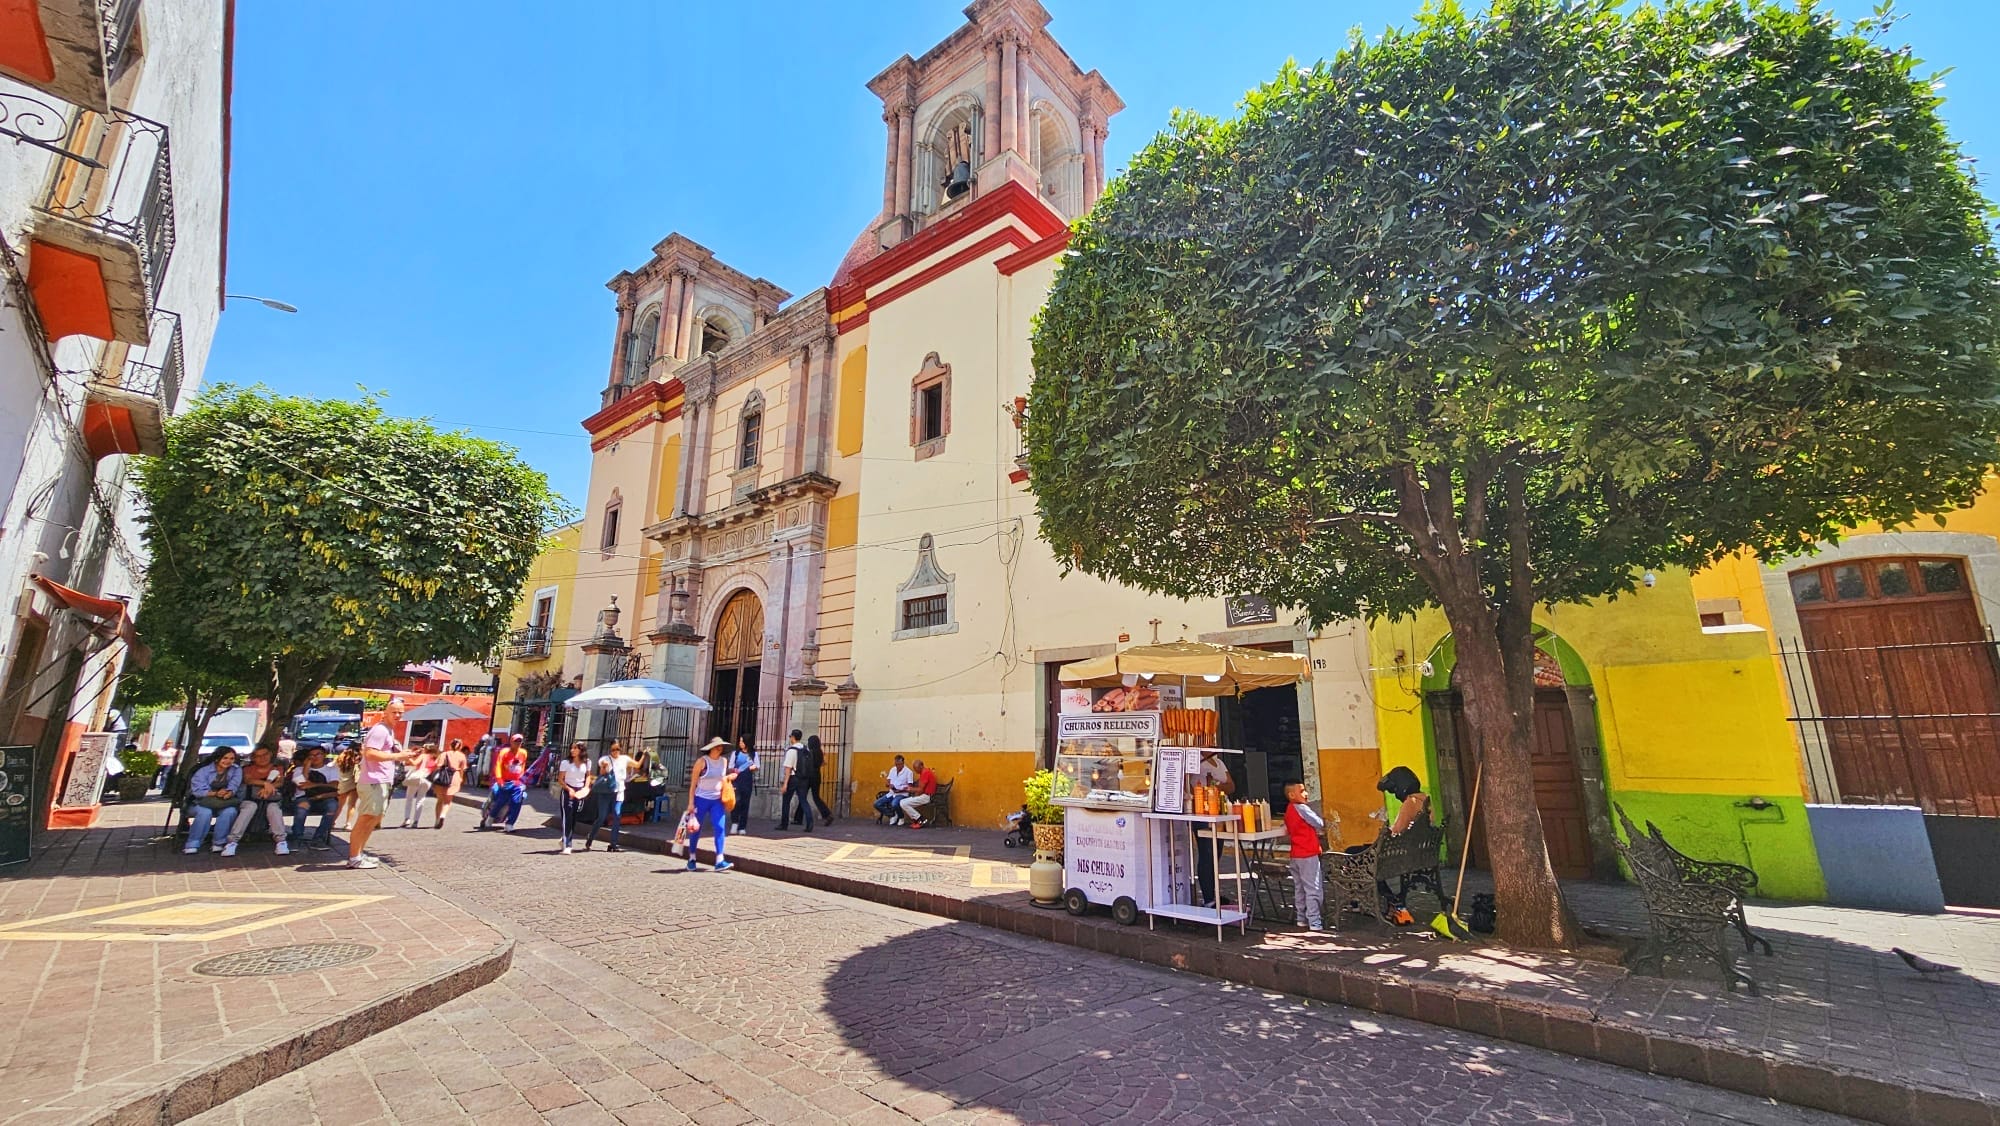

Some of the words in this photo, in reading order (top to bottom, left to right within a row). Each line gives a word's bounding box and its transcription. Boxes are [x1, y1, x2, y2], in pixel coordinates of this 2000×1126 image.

[1064, 721, 1102, 731] CHURROS
[1103, 720, 1150, 730] RELLENOS
[1077, 858, 1090, 874] MIS
[1091, 860, 1125, 878] CHURROS
